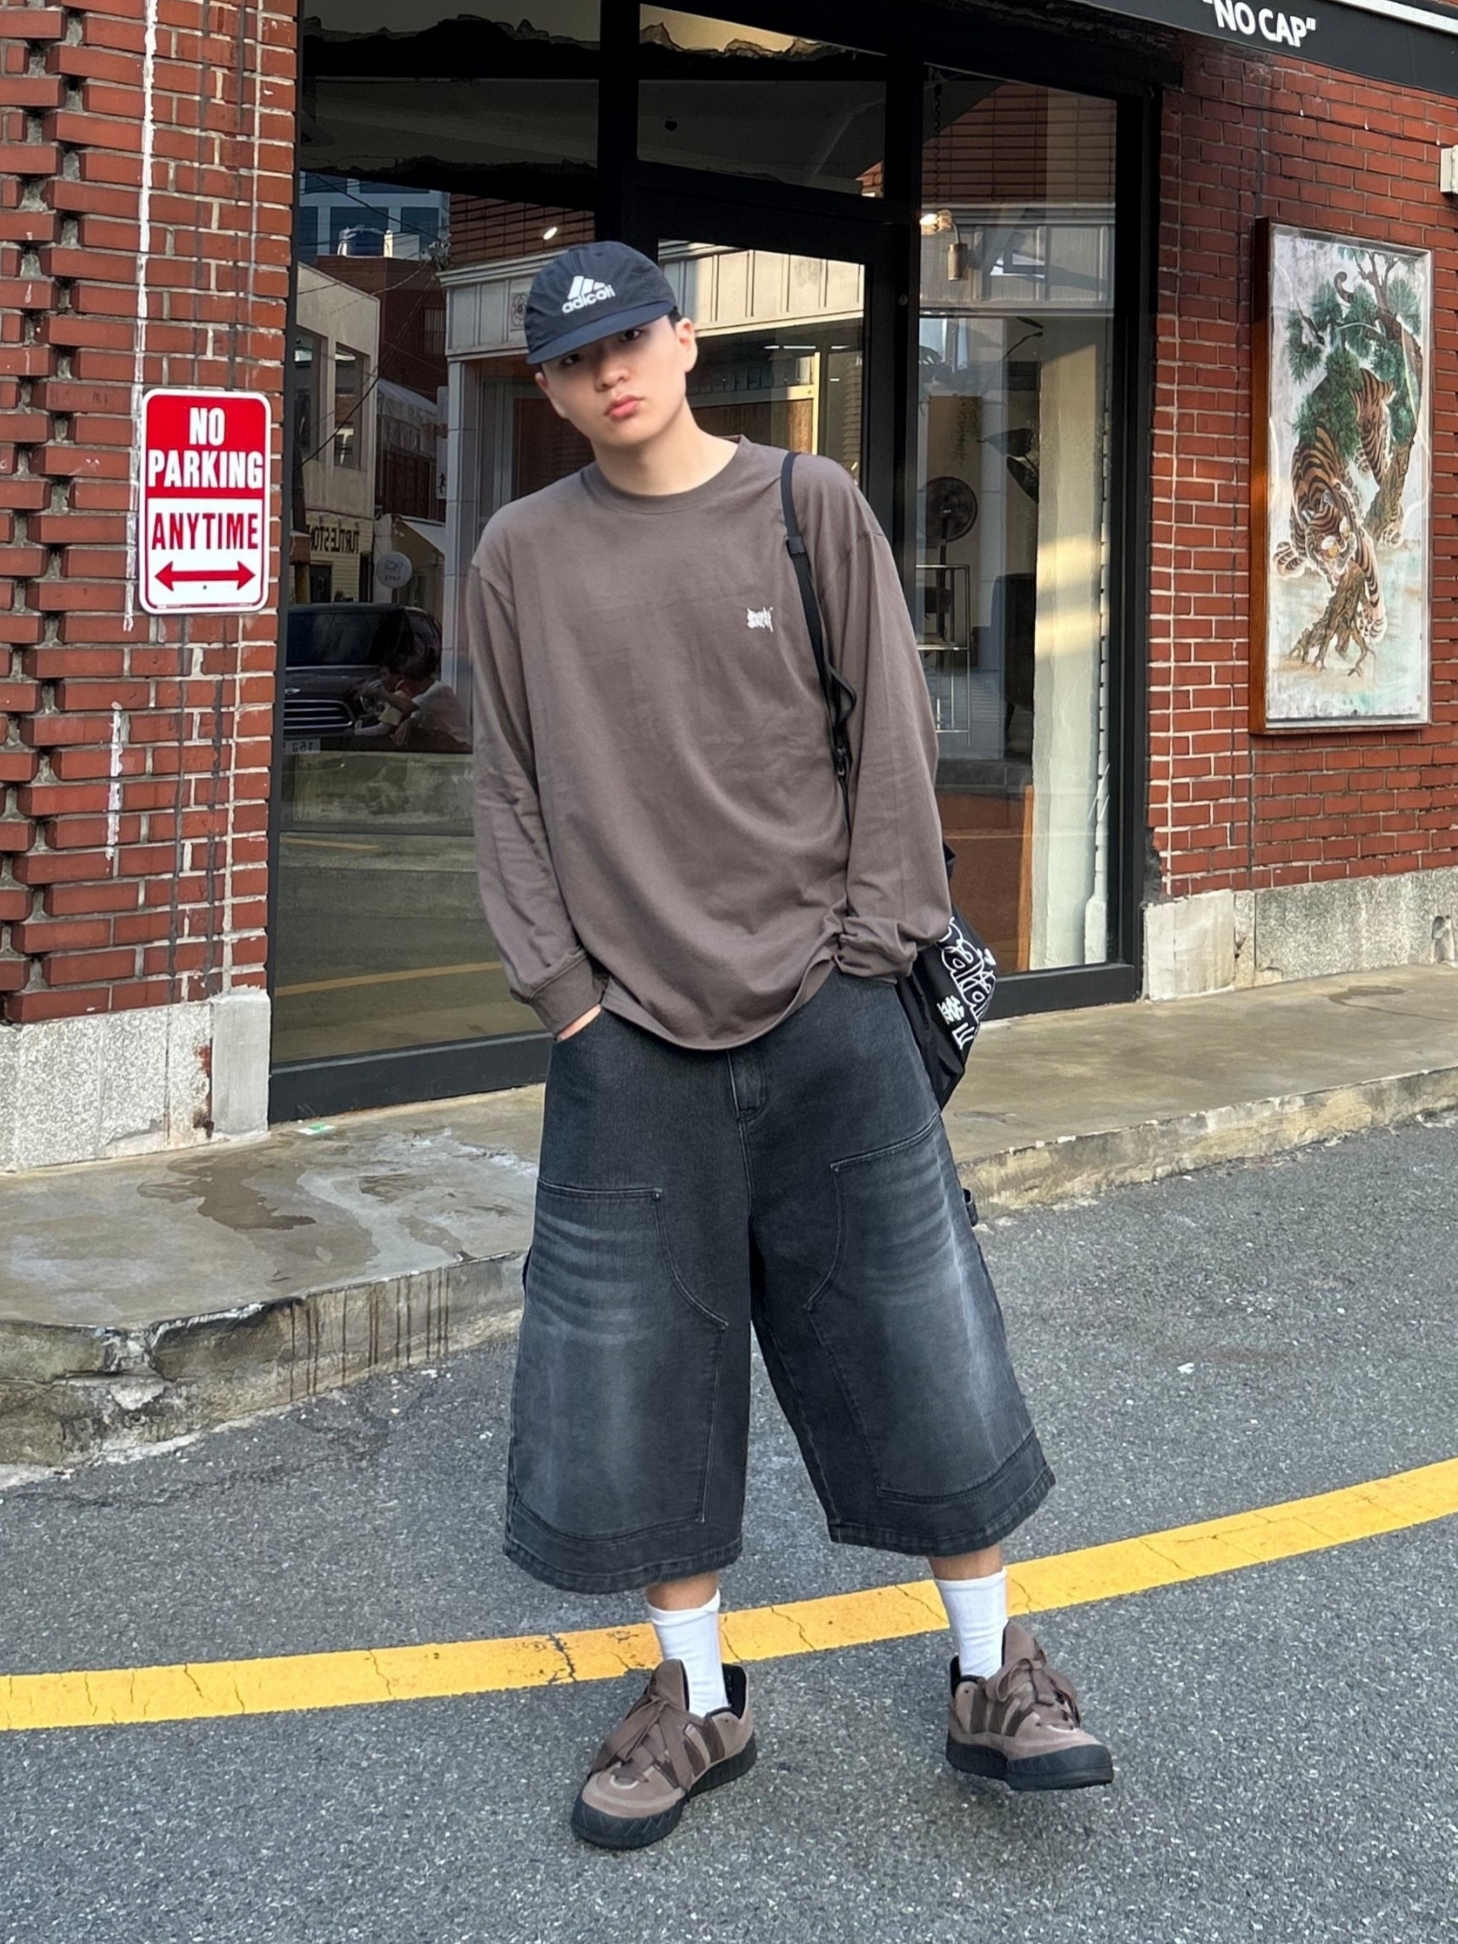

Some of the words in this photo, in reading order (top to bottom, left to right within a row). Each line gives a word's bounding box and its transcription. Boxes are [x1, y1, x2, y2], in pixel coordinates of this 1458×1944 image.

[1258, 8, 1316, 47] CAP"
[189, 407, 225, 446] NO
[148, 449, 263, 489] PARKING
[152, 512, 258, 550] ANYTIME
